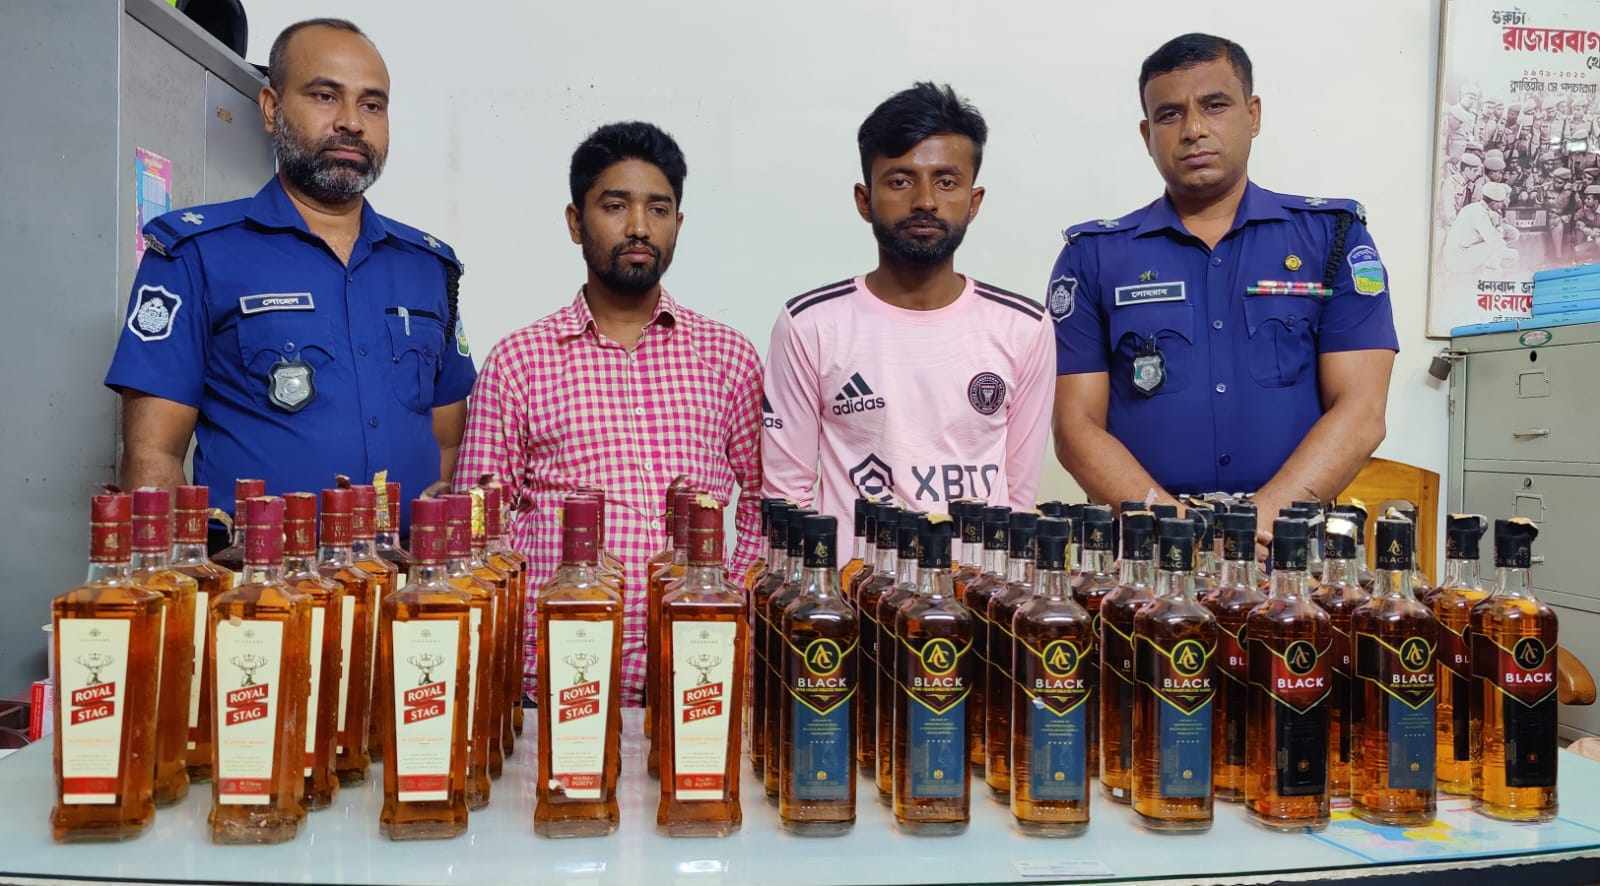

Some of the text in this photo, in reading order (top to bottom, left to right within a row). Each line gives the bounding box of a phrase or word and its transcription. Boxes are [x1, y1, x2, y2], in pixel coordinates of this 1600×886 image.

[832, 396, 885, 416] adidas
[797, 677, 847, 688] BLACK
[914, 677, 963, 687] BLACK
[1035, 678, 1085, 689] BLACK
[1163, 677, 1211, 688] BLACK
[1277, 677, 1324, 689] BLACK
[1392, 673, 1435, 684] BLACK
[1505, 672, 1552, 684] BLACK
[74, 687, 113, 703] ROYAL
[229, 688, 266, 704] ROYAL
[407, 686, 443, 702] ROYAL
[563, 684, 597, 701] ROYAL
[686, 686, 720, 702] ROYAL
[77, 707, 108, 722] STAG
[233, 708, 261, 722] STAG
[410, 707, 440, 721] STAG
[565, 704, 593, 720] STAG
[689, 705, 716, 720] STAG
